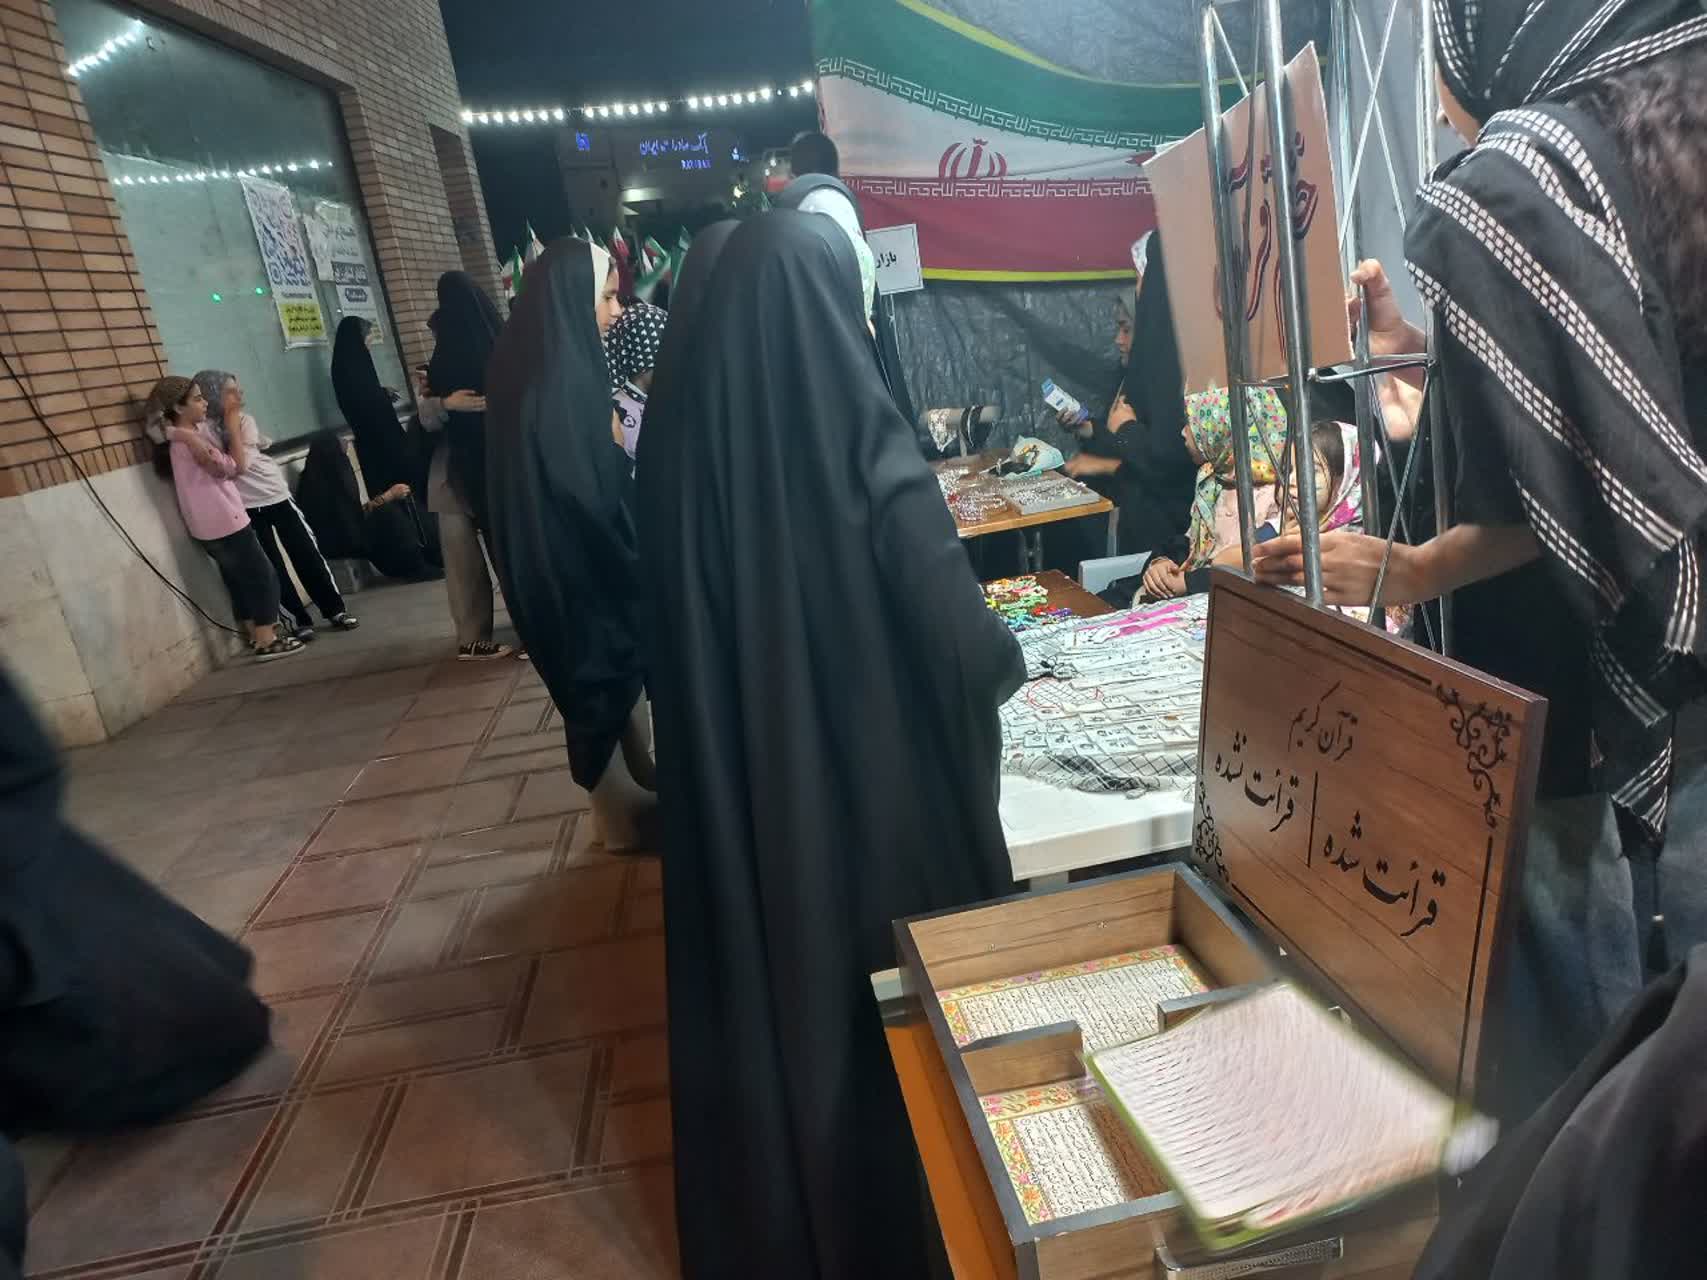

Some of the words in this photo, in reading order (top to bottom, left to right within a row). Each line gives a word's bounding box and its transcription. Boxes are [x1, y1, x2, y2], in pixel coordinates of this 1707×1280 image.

[876, 251, 897, 269] بازار
[1287, 680, 1343, 752] کریم
[1318, 710, 1358, 762] قرآن
[1215, 730, 1247, 783] نشده
[1324, 810, 1362, 873] شده
